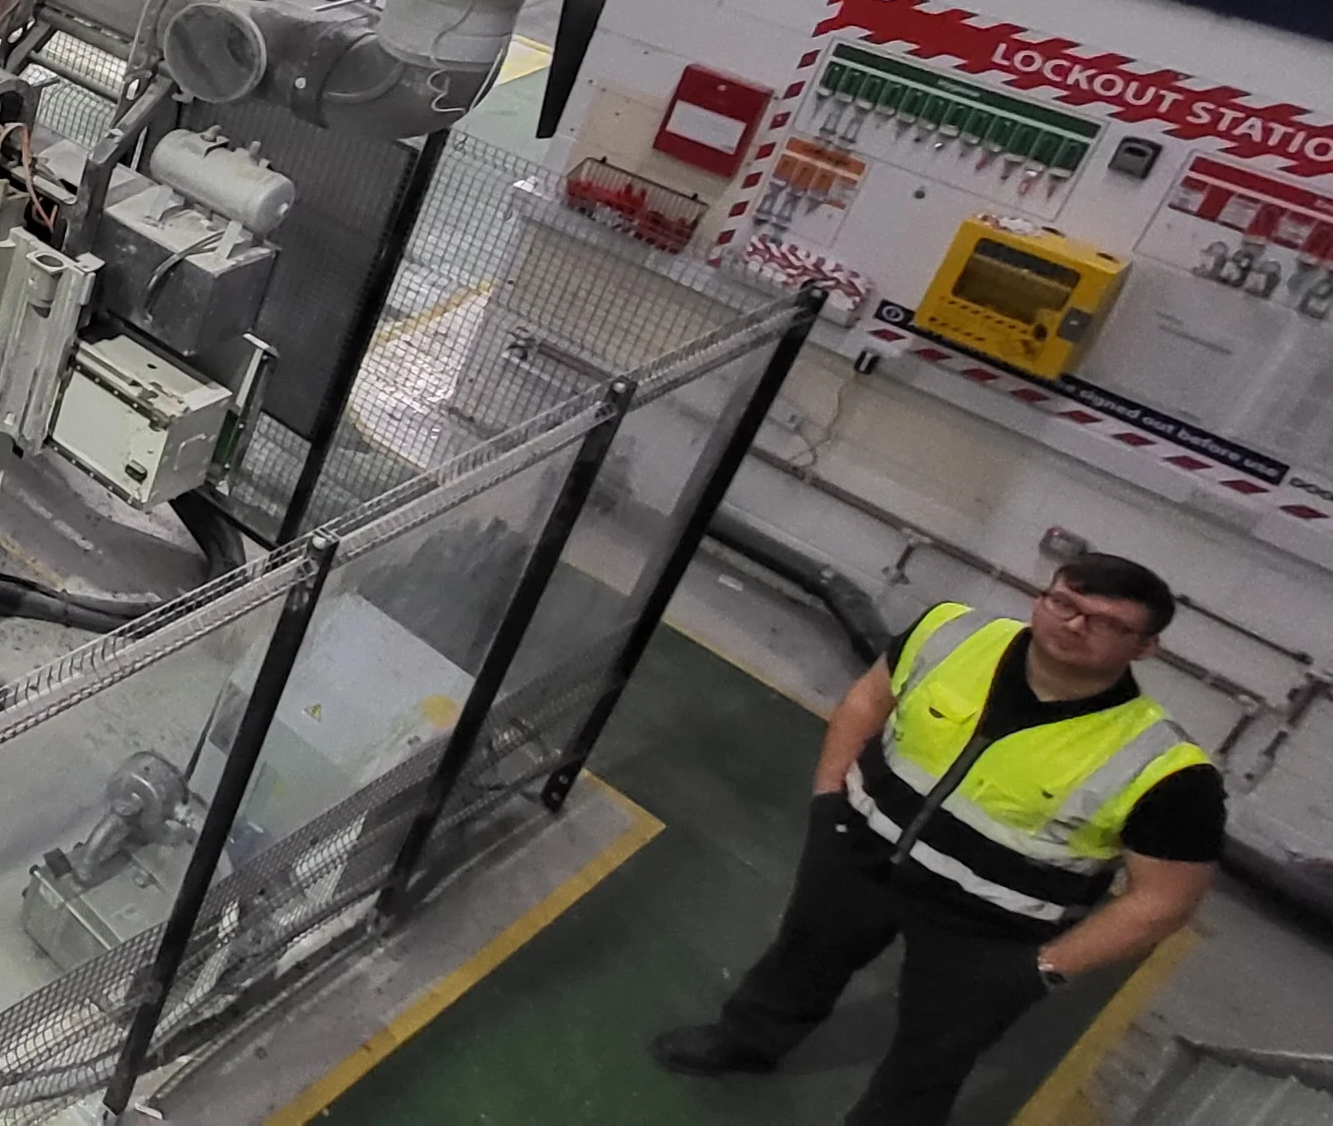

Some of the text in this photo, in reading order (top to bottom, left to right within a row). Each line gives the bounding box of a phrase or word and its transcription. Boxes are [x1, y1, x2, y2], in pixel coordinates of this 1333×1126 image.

[992, 43, 1183, 113] LOCKOUT
[1141, 415, 1175, 439] out
[1177, 429, 1240, 461] before
[1243, 456, 1280, 479] use
